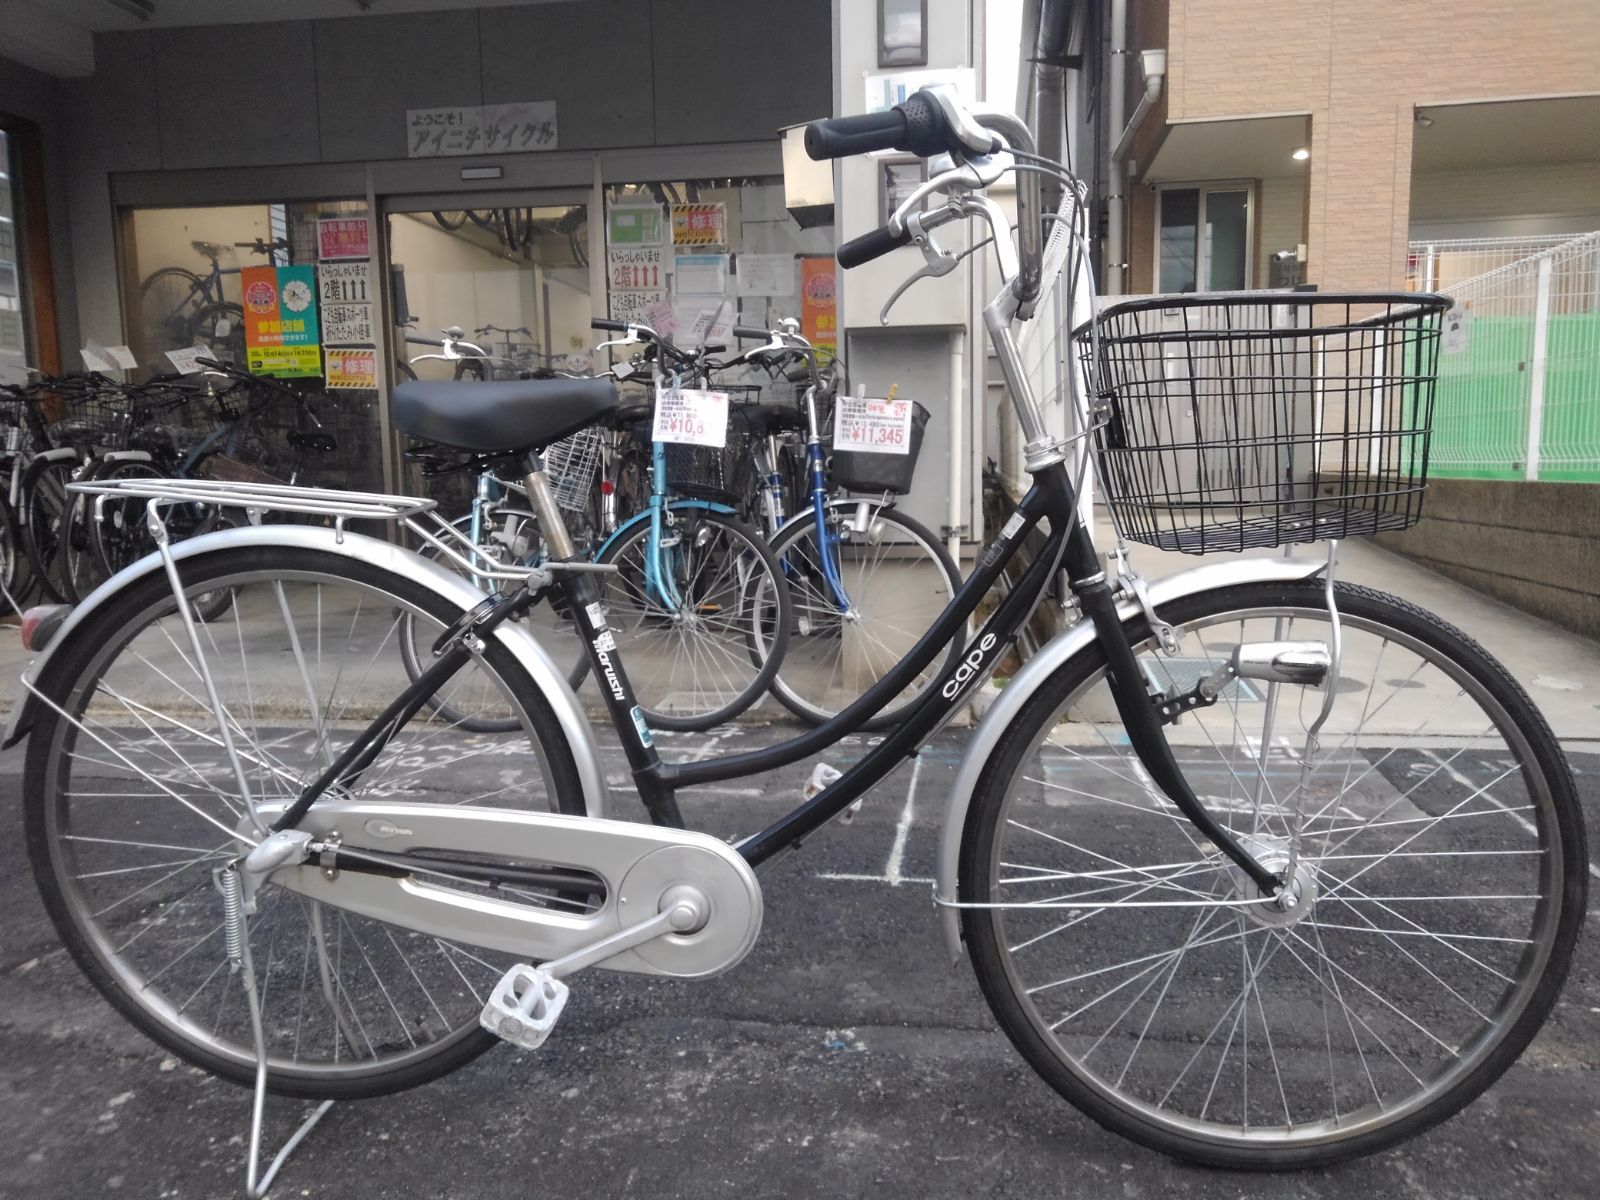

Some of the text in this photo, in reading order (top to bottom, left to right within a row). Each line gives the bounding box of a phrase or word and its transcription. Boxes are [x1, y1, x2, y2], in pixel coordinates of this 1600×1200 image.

[413, 122, 555, 152] アイニチサイクル
[692, 213, 723, 229] 修理
[674, 230, 716, 239] welcome
[611, 250, 661, 263] いらっしゃいませ
[321, 265, 368, 278] いらっしゃいませ
[614, 265, 631, 288] 2階
[324, 279, 341, 301] 2階
[345, 358, 374, 374] 修理
[329, 374, 367, 382] welcome
[852, 426, 903, 445] ¥11,345
[942, 632, 997, 699] cape
